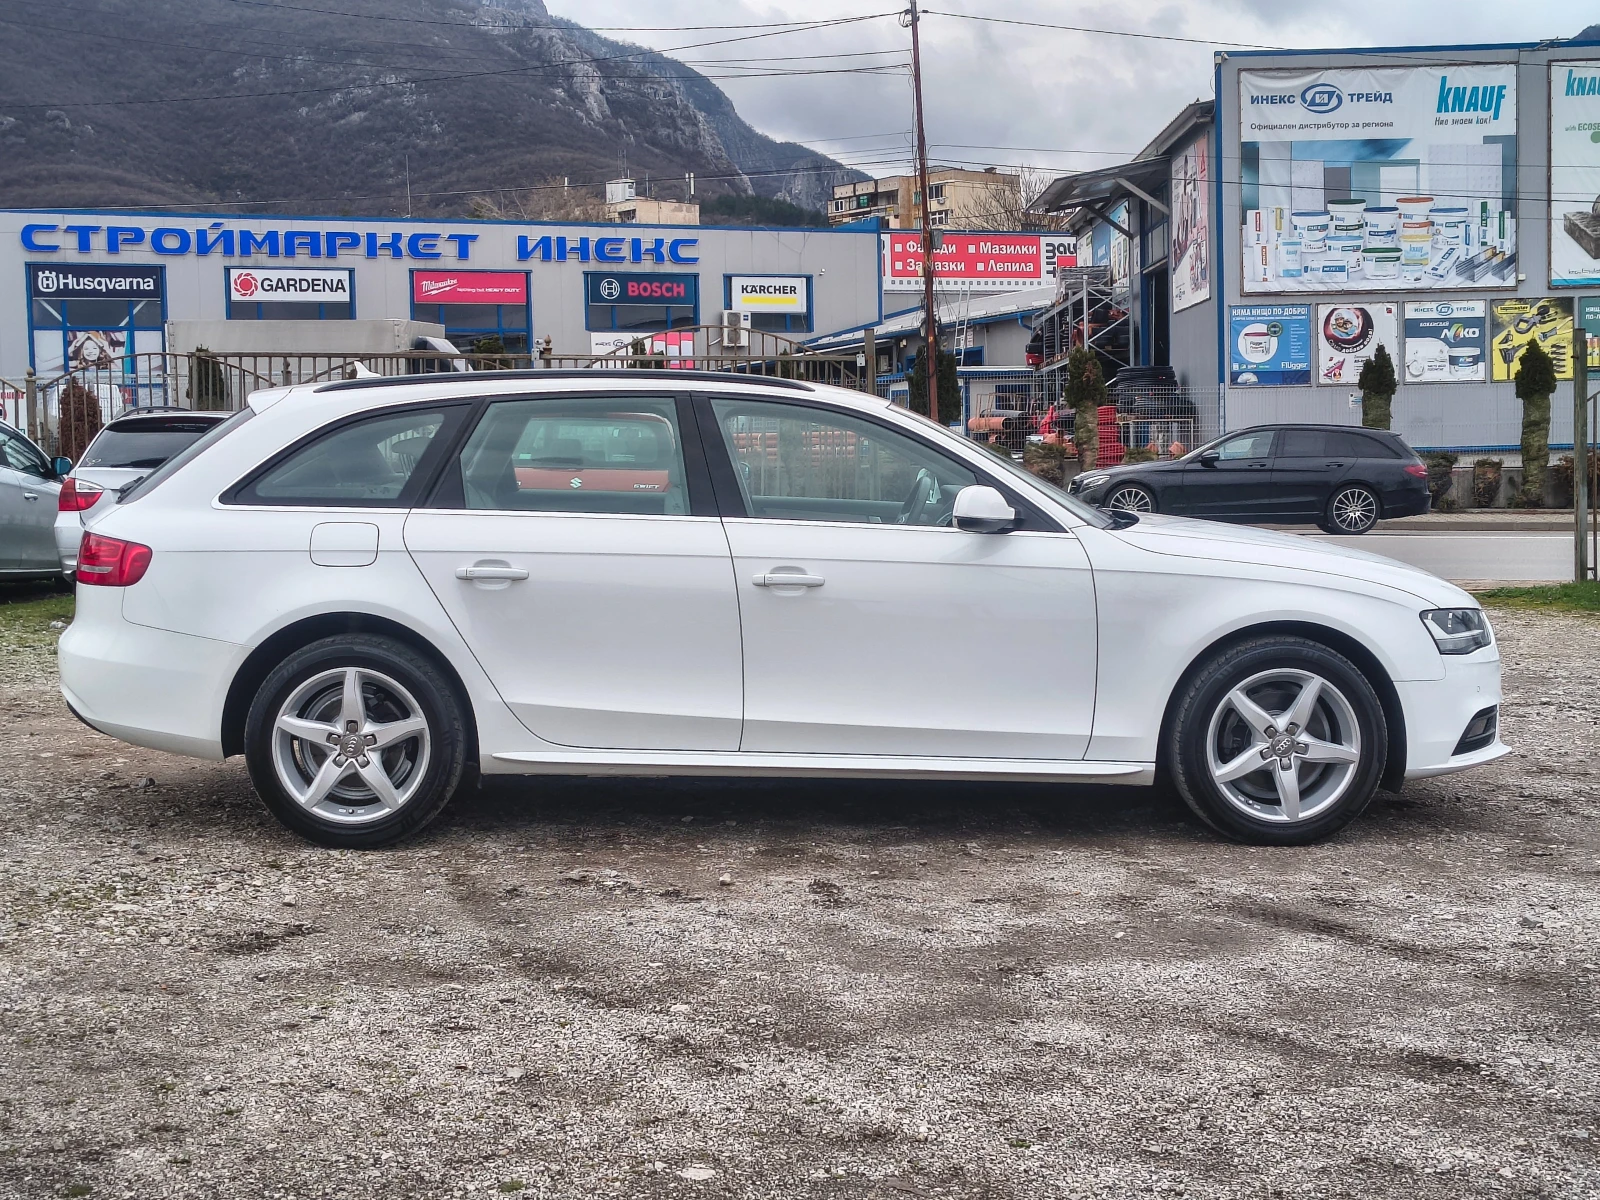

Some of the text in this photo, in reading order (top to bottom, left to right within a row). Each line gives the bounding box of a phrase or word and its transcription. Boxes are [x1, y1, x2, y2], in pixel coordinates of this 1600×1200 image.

[1250, 95, 1296, 105] ИНЕКС
[1347, 91, 1393, 103] ТРЕЙД
[1250, 123, 1297, 131] Официален
[1298, 122, 1350, 130] дистрибутор
[1451, 118, 1473, 126] знаем
[20, 222, 701, 265] СТРОЙМАРКЕТ ИНЕКС
[906, 241, 1037, 255] Фади Мазилки
[906, 259, 1034, 272] Заазки Лепила
[59, 273, 154, 293] Husqvarna
[260, 277, 346, 293] GARDENA
[420, 278, 458, 292] Milwaukee
[627, 281, 685, 297] BOSCH
[741, 284, 797, 295] KÄRCHER
[1232, 307, 1308, 316] НЯМА НИЩО ПО-ДОБРО!
